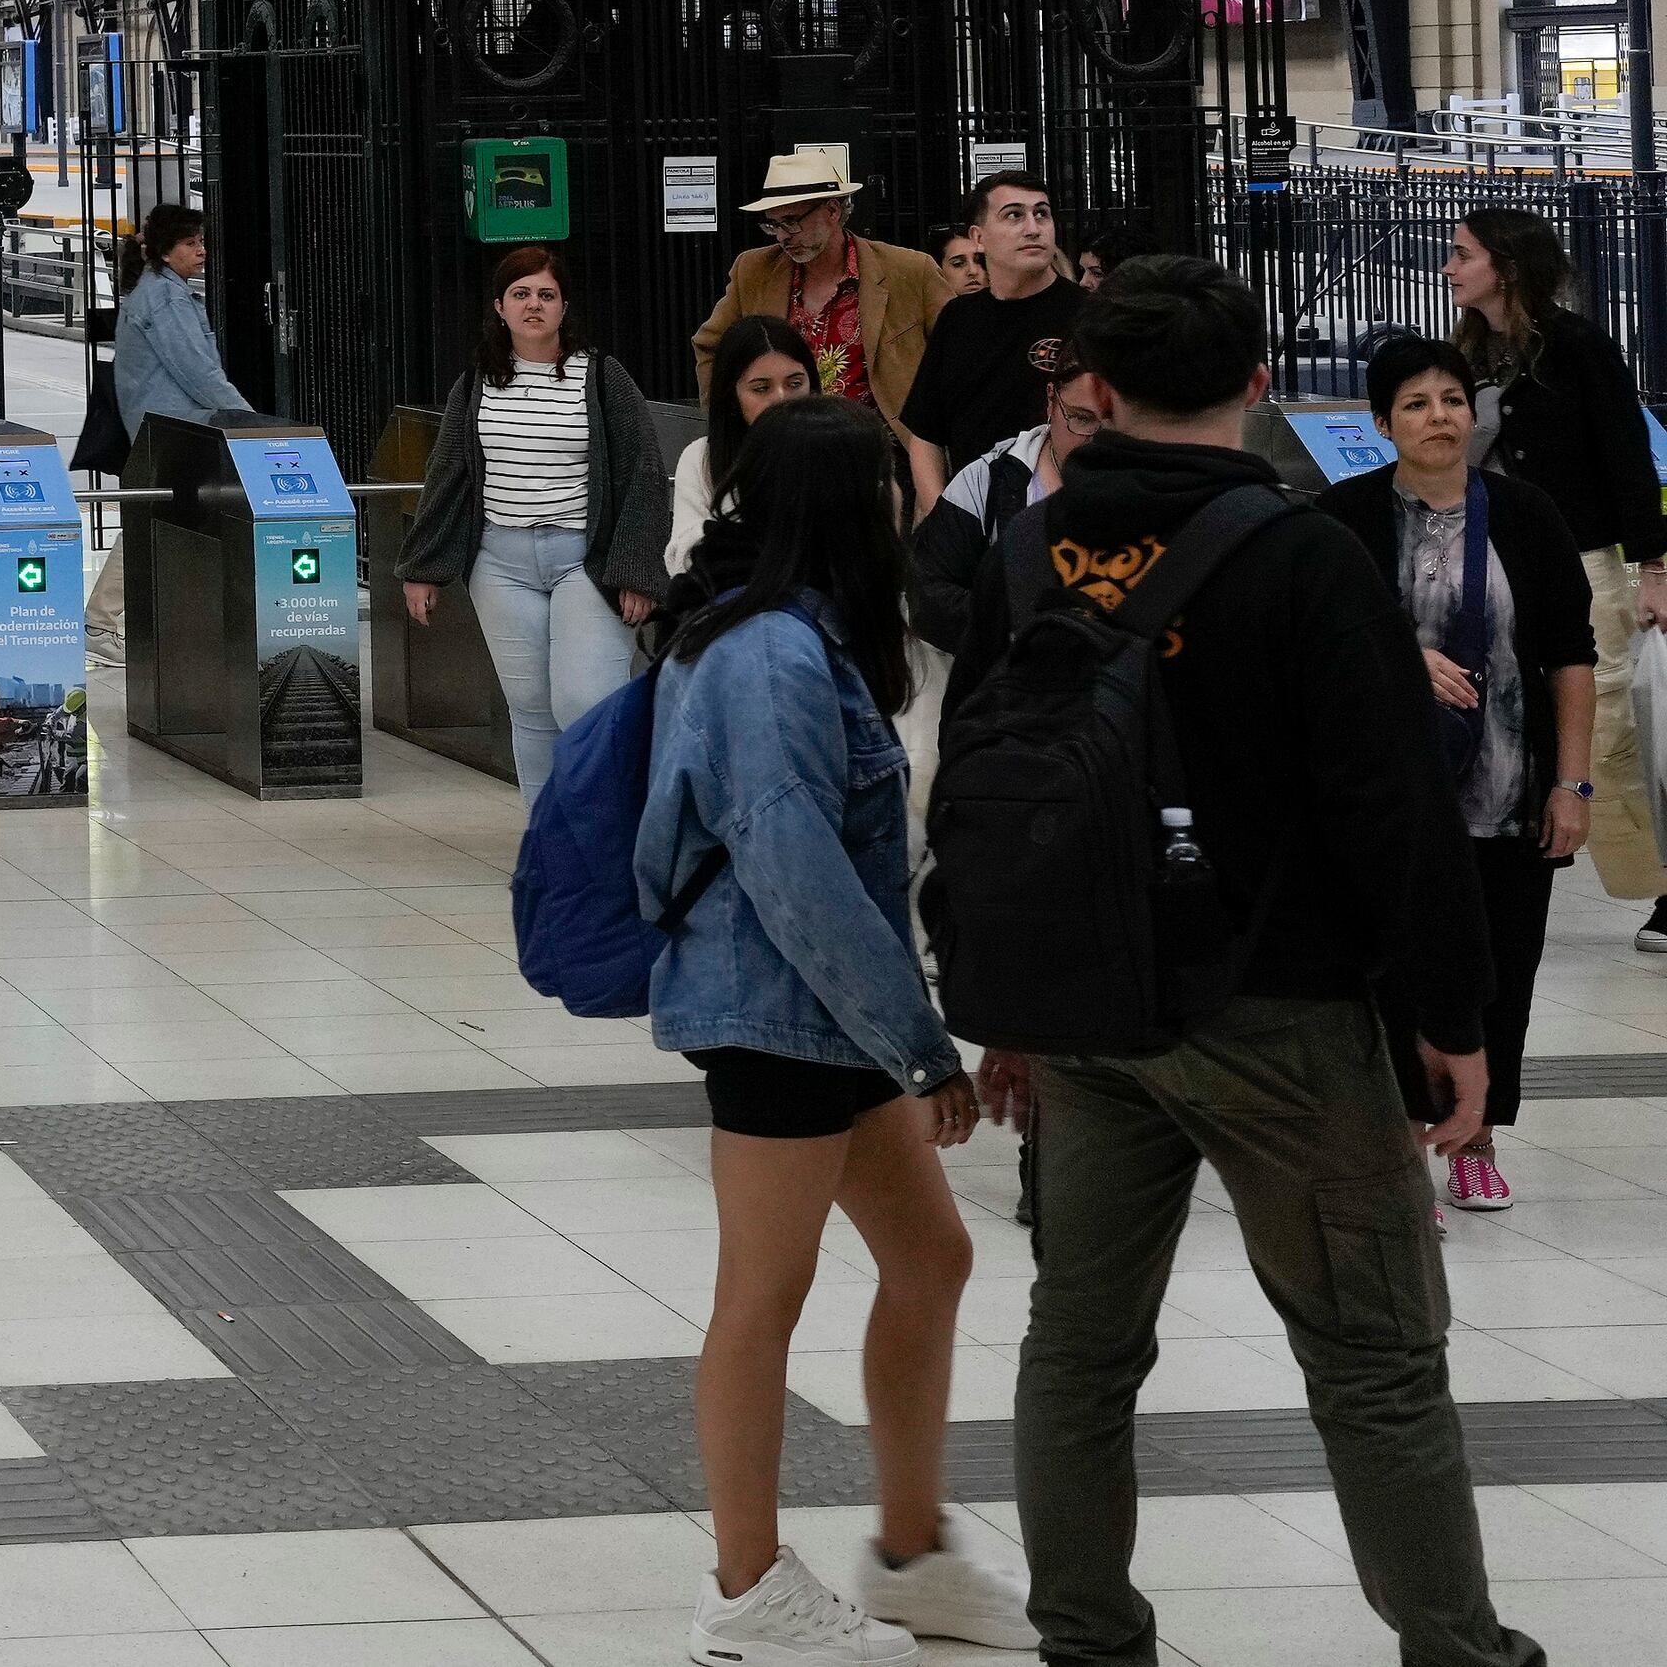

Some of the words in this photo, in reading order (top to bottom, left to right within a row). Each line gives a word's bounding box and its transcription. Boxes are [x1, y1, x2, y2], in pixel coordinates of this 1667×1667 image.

[319, 597, 338, 607] km
[10, 606, 37, 616] Plan
[40, 606, 55, 616] de
[287, 612, 302, 622] de
[304, 611, 329, 621] vías
[271, 625, 346, 638] recuperadas
[10, 634, 77, 646] Transporte
